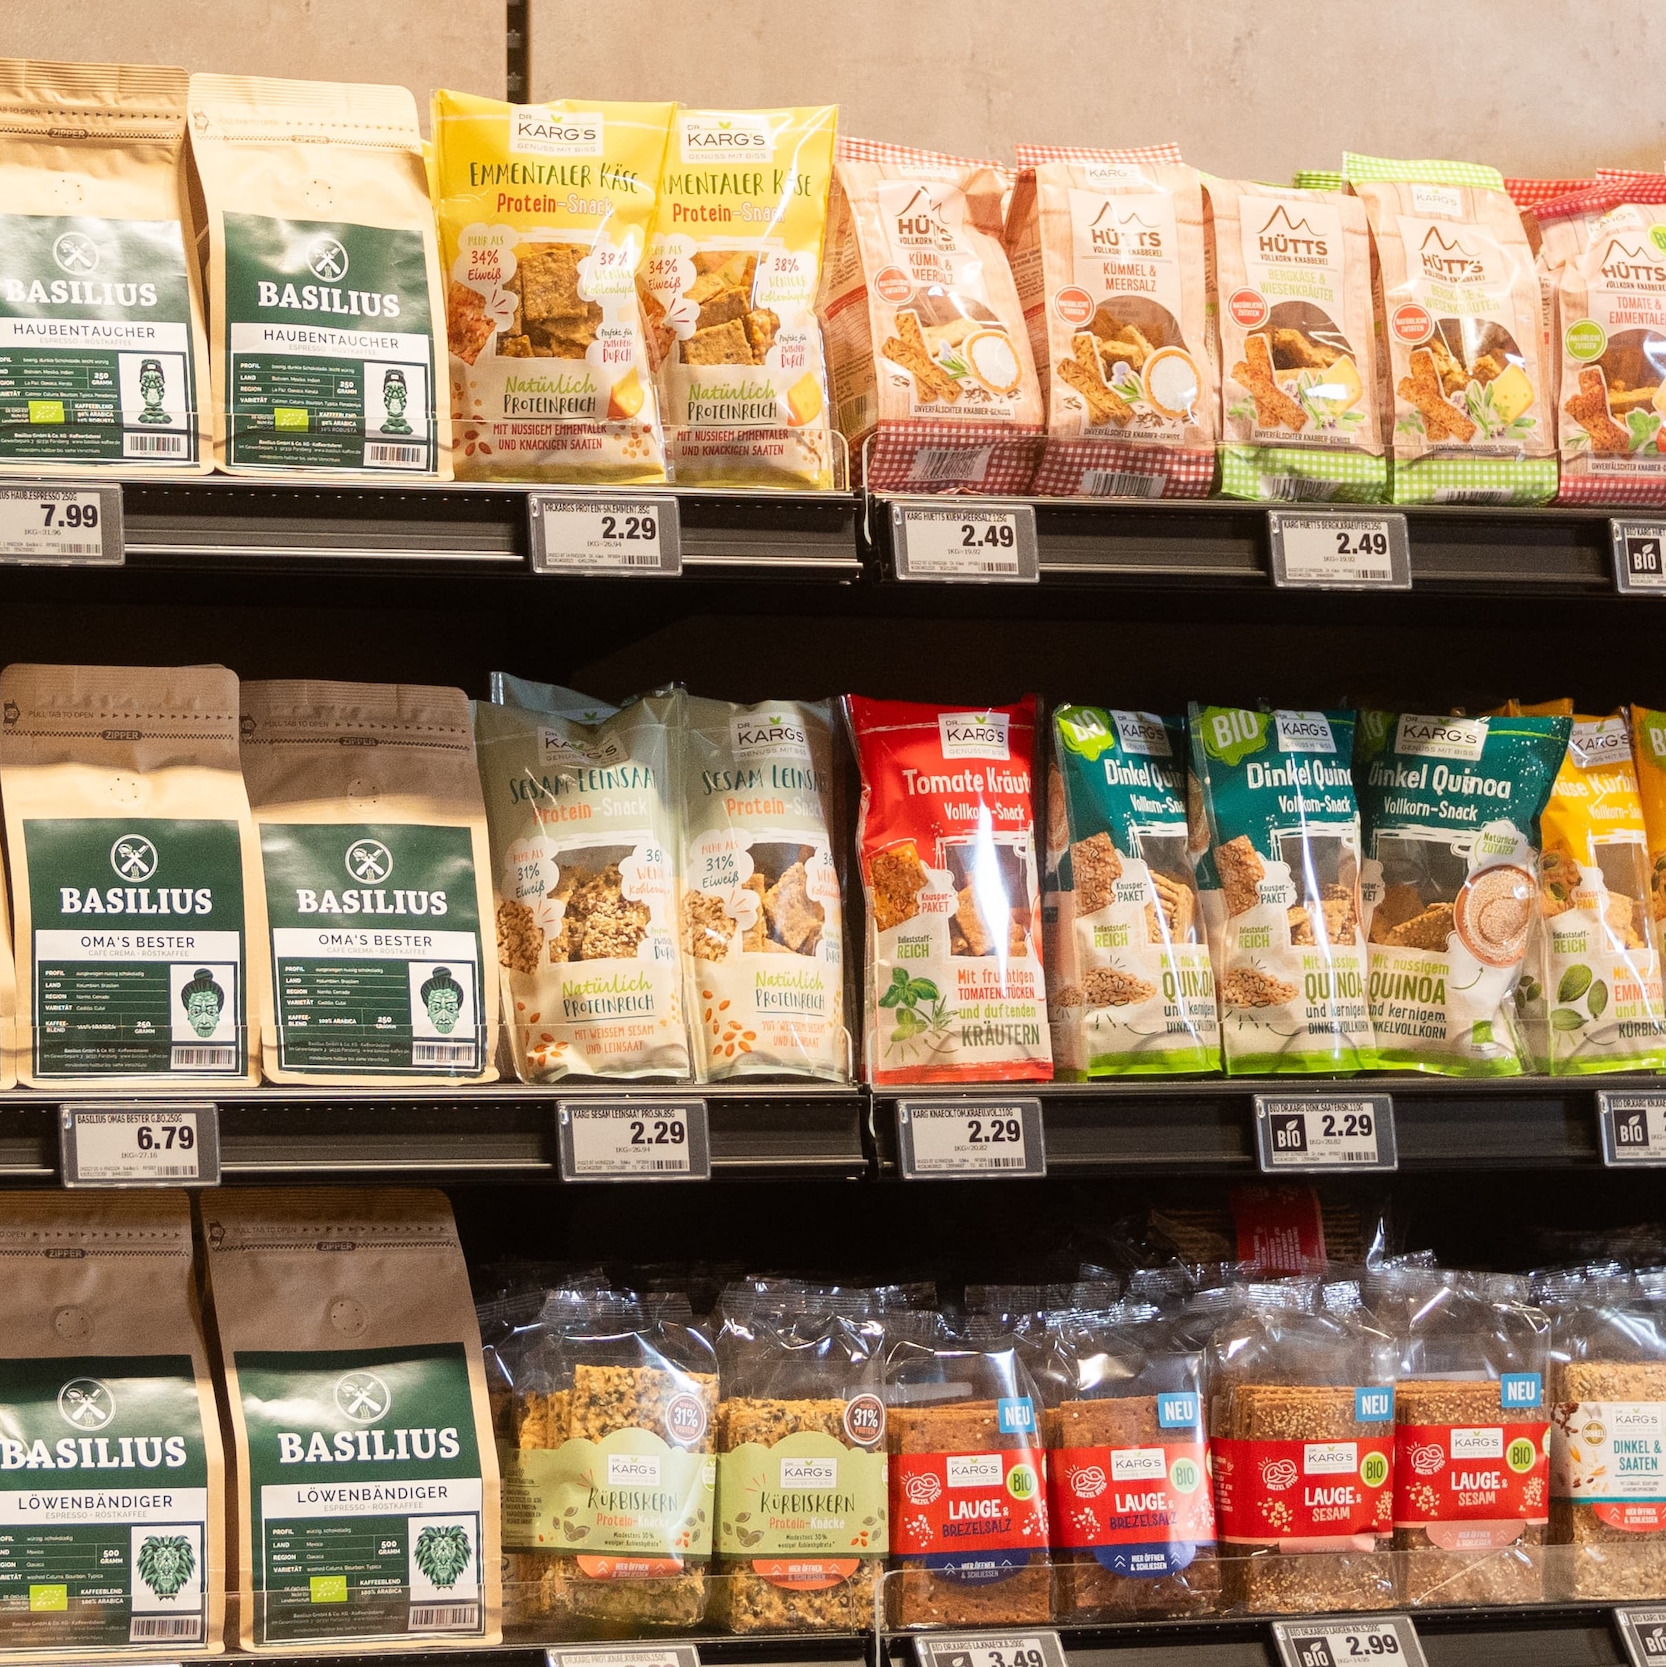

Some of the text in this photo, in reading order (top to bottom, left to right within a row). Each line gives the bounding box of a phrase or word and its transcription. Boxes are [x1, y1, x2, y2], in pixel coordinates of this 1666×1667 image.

[470, 162, 638, 194] EMMENTALER KÄSE
[497, 194, 613, 217] Protein-Snack
[1259, 233, 1328, 256] HÜTTS
[471, 250, 499, 266] 34%
[1104, 261, 1143, 277] KÜMMEL
[468, 268, 502, 284] Eiweiß
[1602, 263, 1666, 282] HÜTTS
[4, 277, 158, 307] BASILIUS
[1106, 276, 1156, 293] MEERSALZ
[1261, 281, 1333, 302] WIESENKRÄUTER
[258, 280, 400, 318] BASILIUS
[14, 321, 155, 340] HAUBENTAUCHER
[264, 328, 400, 351] HAUBENTAUCHER
[506, 375, 597, 396] Natürlich
[503, 396, 595, 415] PROTEINREICH
[40, 503, 98, 528] 7.99
[601, 516, 657, 540] 2.29
[961, 524, 1014, 548] 2.49
[1336, 532, 1387, 555] 2.49
[1633, 554, 1657, 571] BIO
[105, 731, 140, 740] ZIPPER
[1213, 714, 1259, 749] BIO
[1369, 761, 1511, 799] Dinkel Quinoa
[1384, 797, 1477, 821] Vollkorn-Snack
[60, 888, 212, 914] BASILIUS
[296, 888, 447, 916] BASILIUS
[81, 934, 195, 948] OMA'S BESTER
[319, 933, 432, 947] OMA'S BESTER
[897, 942, 929, 959] REICH
[562, 975, 653, 998] Natürlich
[1370, 972, 1446, 1005] QUINOA
[563, 994, 654, 1017] PROTEINREICH
[961, 1022, 1040, 1047] KRÄUTERN
[630, 1121, 686, 1145] 2.29
[968, 1119, 1021, 1143] 2.29
[1322, 1114, 1373, 1137] 2.29
[137, 1125, 194, 1150] 6.79
[1362, 1396, 1387, 1415] NEU
[853, 1408, 877, 1427] 31%
[0, 1437, 186, 1470] BASILIUS
[279, 1427, 459, 1464] BASILIUS
[1614, 1441, 1650, 1455] DINKEL
[1365, 1460, 1384, 1479] BIO
[1619, 1458, 1657, 1471] SAATEN
[19, 1493, 173, 1511] LÖWENBÄNDIGER
[297, 1485, 448, 1504] LÖWENBÄNDIGER
[760, 1491, 855, 1514] KÜRBISKERN
[1305, 1486, 1354, 1506] LAUGE
[949, 1499, 1000, 1519] LAUGE
[1312, 1506, 1350, 1522] SESAM
[942, 1518, 1011, 1538] BREZELSALZ
[103, 1549, 120, 1557] 500
[1345, 1634, 1399, 1656] 2.99
